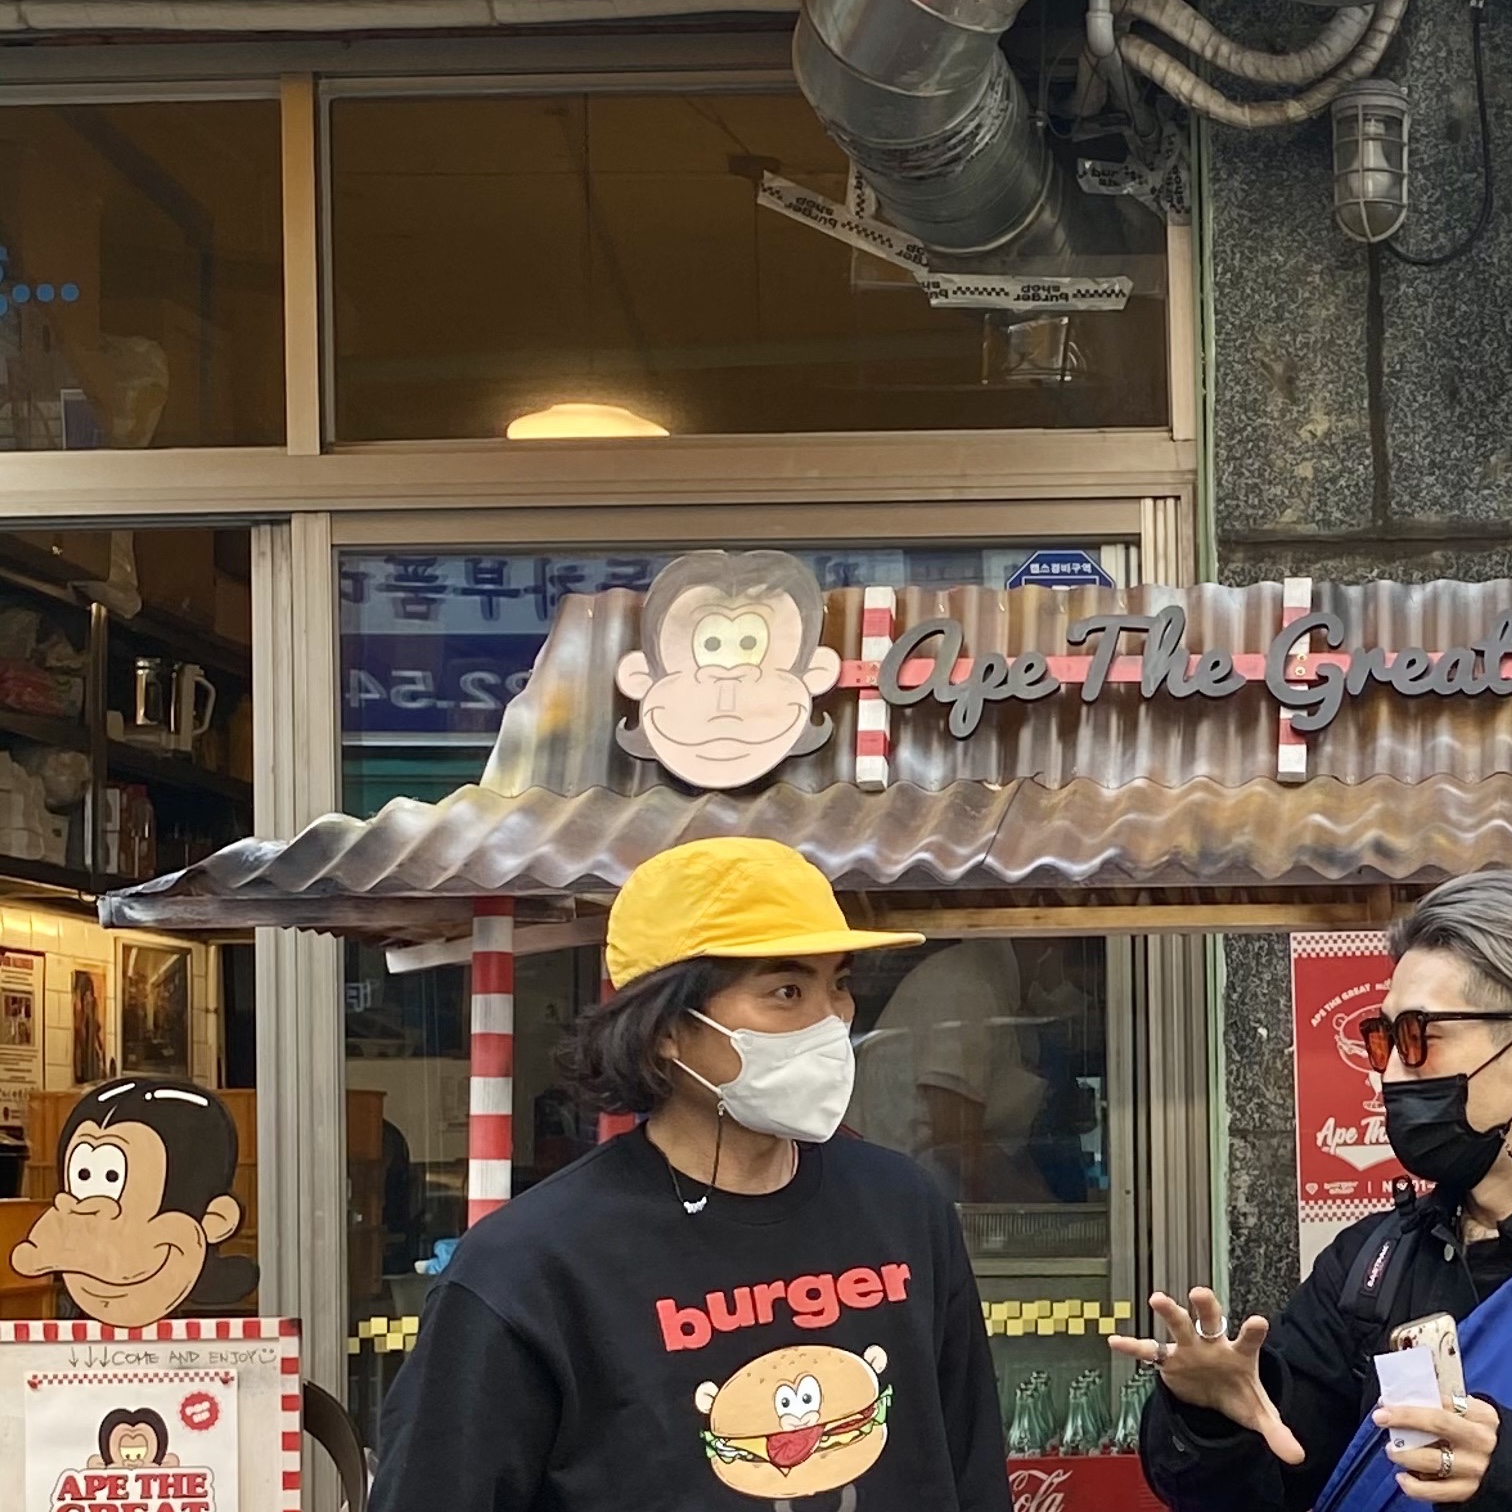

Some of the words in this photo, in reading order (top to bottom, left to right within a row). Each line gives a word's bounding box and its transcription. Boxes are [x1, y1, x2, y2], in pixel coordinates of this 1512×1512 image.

[1012, 292, 1070, 303] burger
[1020, 284, 1061, 294] shop
[879, 619, 1060, 738] Ape
[1066, 606, 1245, 701] The
[1311, 1007, 1328, 1027] APE
[1323, 995, 1343, 1017] THE
[1341, 983, 1372, 1001] GREAT
[1316, 1117, 1359, 1146] Ape
[1360, 1116, 1391, 1145] Th
[656, 1261, 911, 1351] burger
[112, 1350, 160, 1366] COME
[169, 1350, 200, 1364] AND
[208, 1350, 257, 1364] ENJOY
[57, 1474, 129, 1501] APE
[135, 1473, 208, 1499] THE
